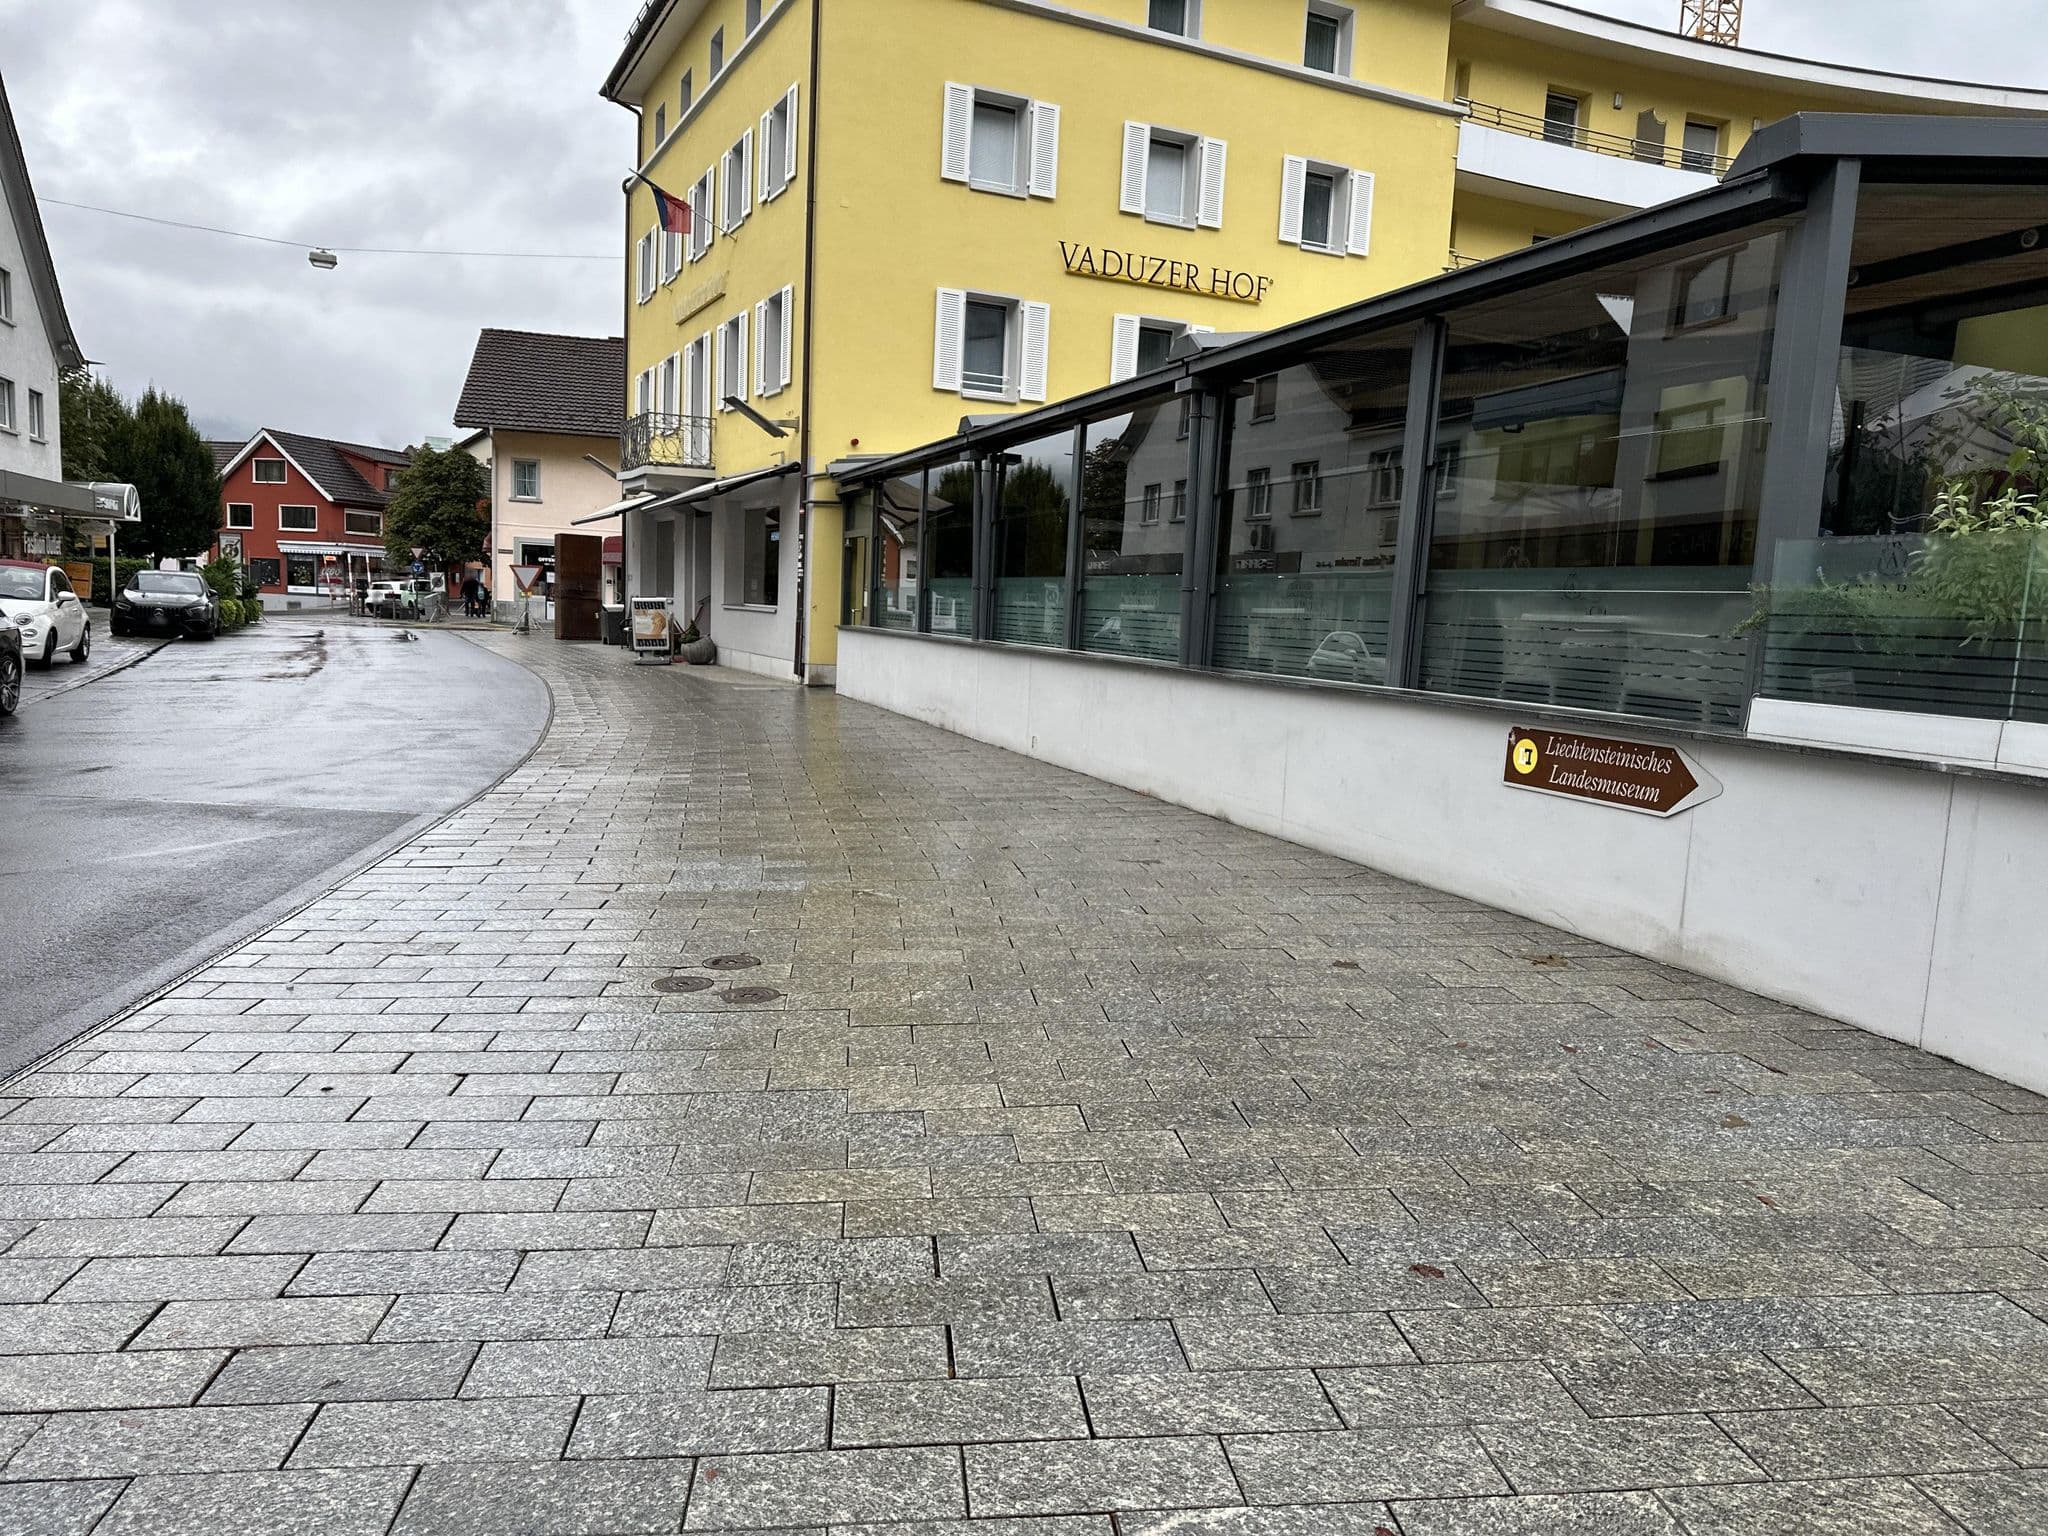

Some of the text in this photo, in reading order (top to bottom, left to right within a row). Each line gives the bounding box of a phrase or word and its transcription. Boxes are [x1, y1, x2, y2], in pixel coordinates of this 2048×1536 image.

[1058, 240, 1270, 301] VADUZER HOF
[1545, 736, 1673, 775] Liechtensteinisches
[1548, 764, 1661, 804] Landesmuseum
